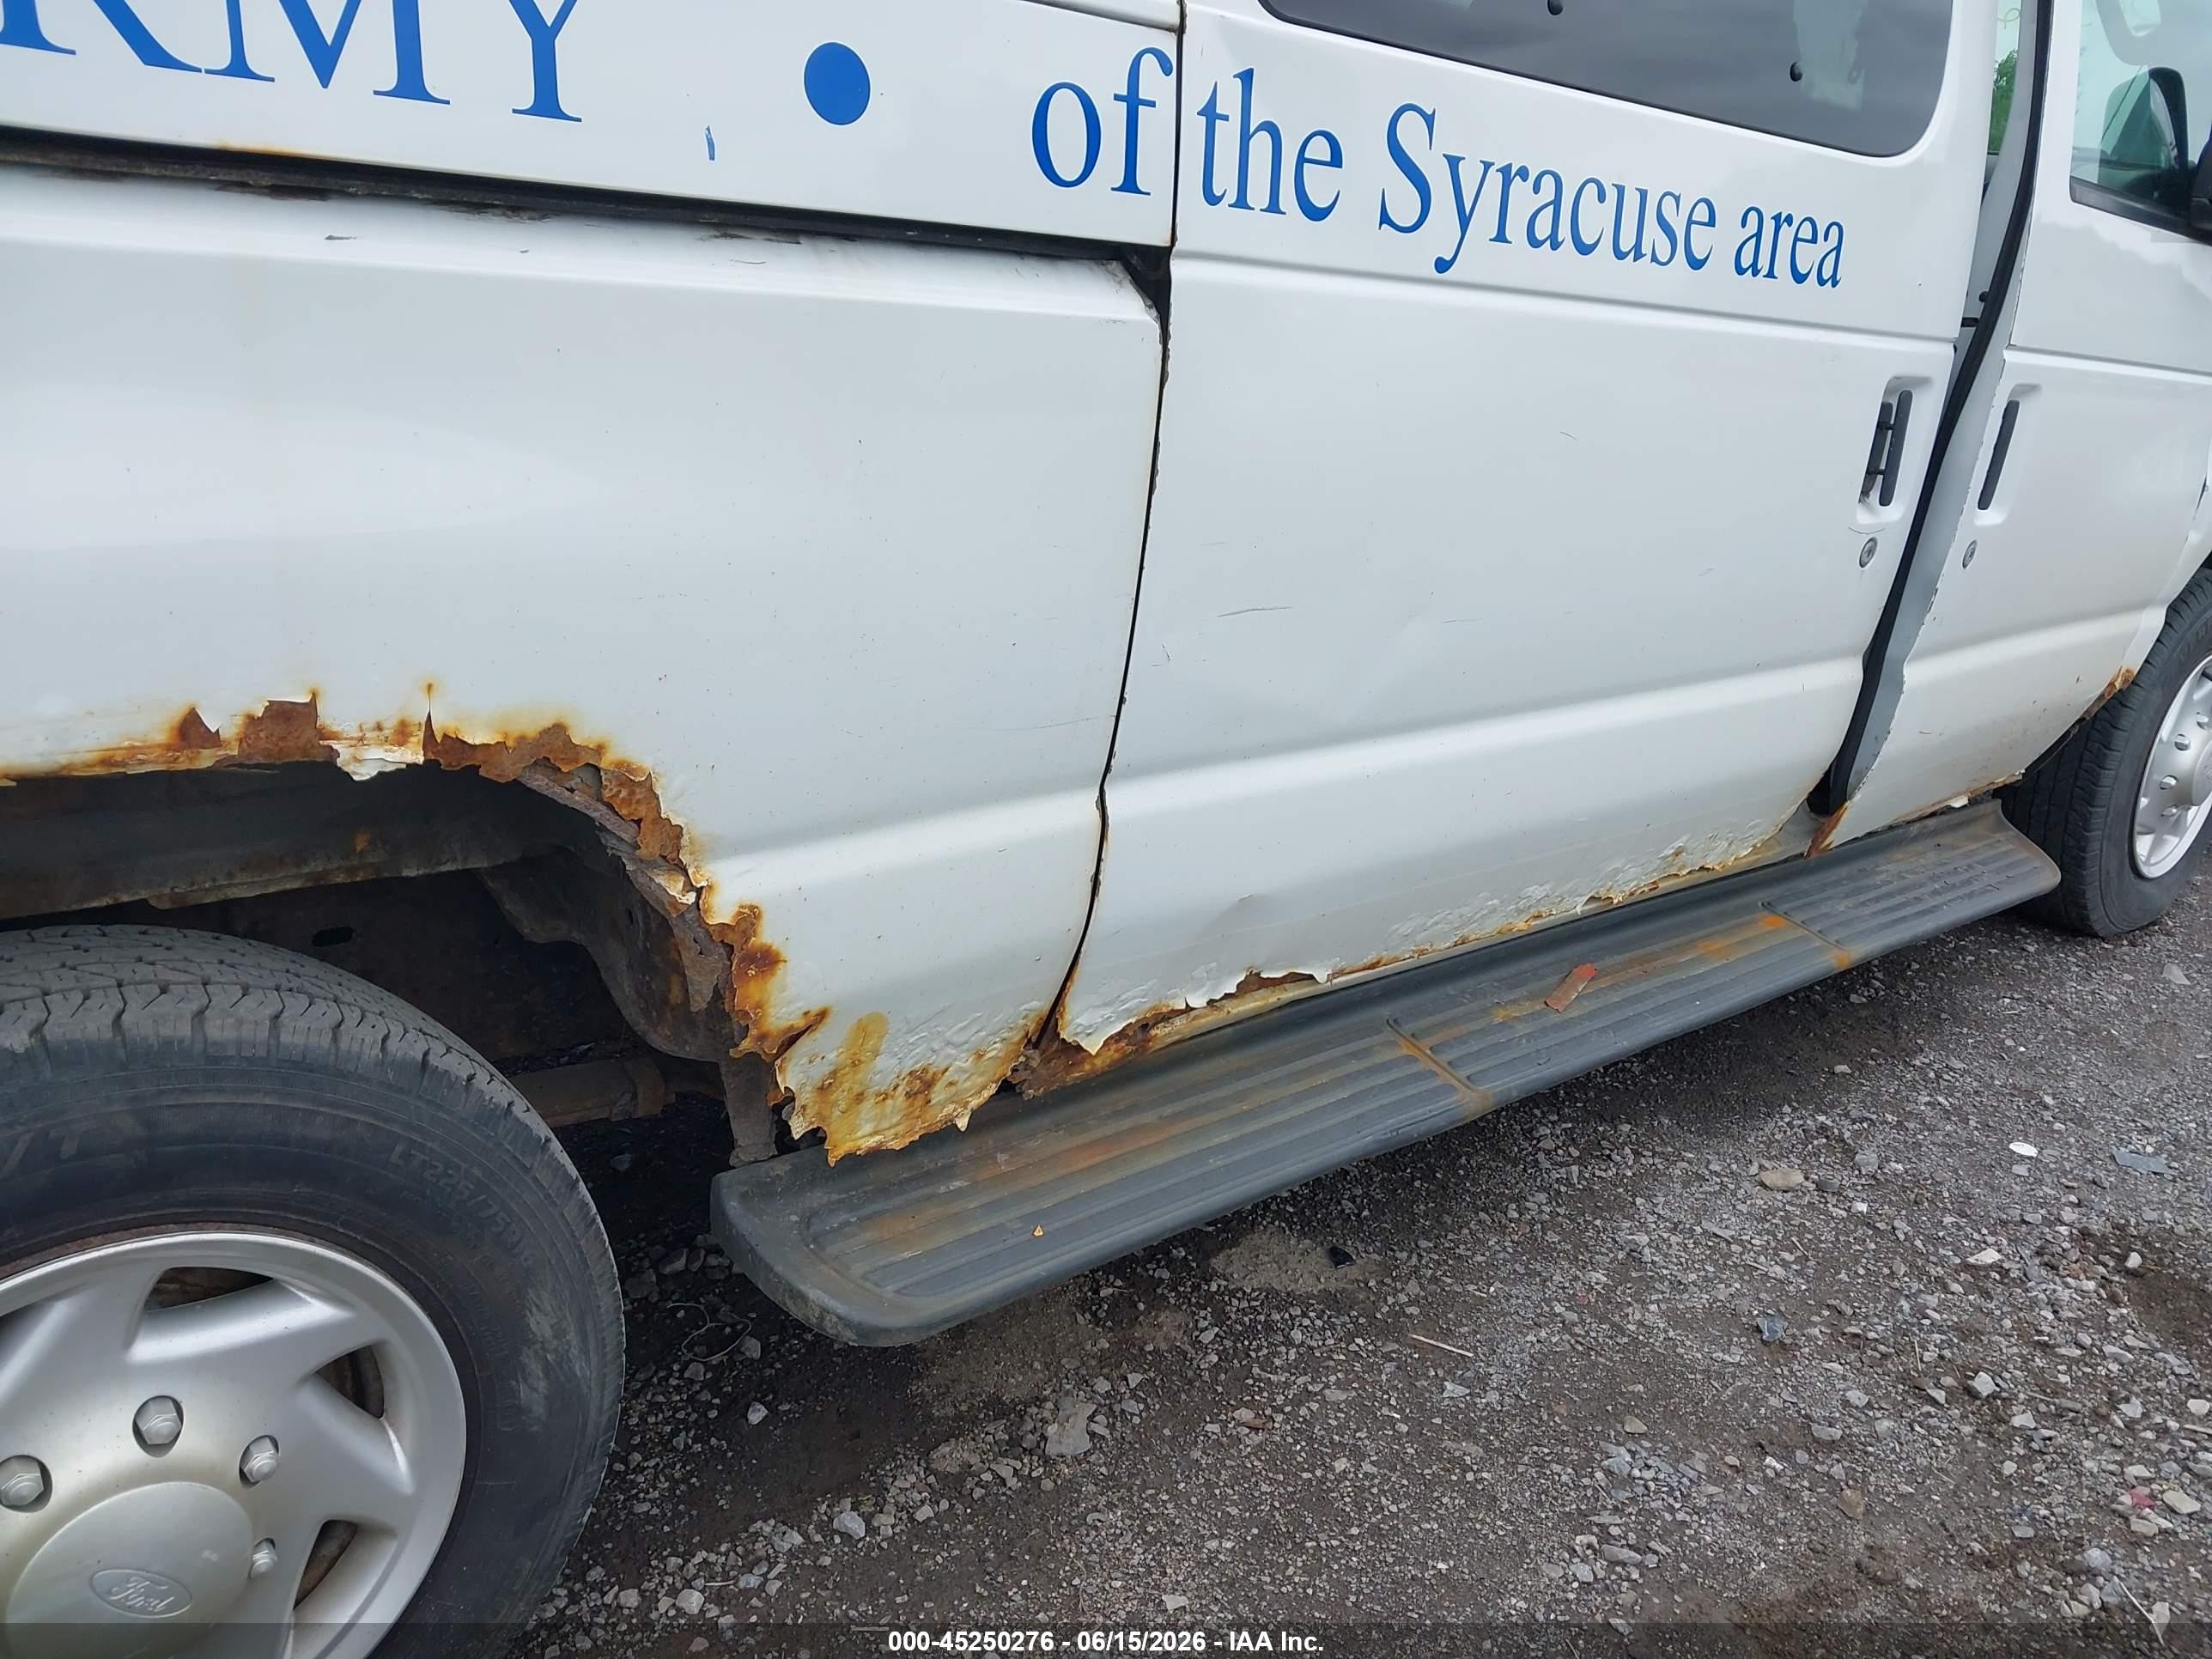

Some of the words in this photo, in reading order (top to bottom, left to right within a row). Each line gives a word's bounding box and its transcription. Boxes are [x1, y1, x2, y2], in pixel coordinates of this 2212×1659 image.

[1031, 47, 1174, 198] of
[1197, 68, 1344, 223] the
[1378, 102, 1717, 275] Syracuse
[1733, 205, 1844, 289] area
[108, 1575, 176, 1613] Ford
